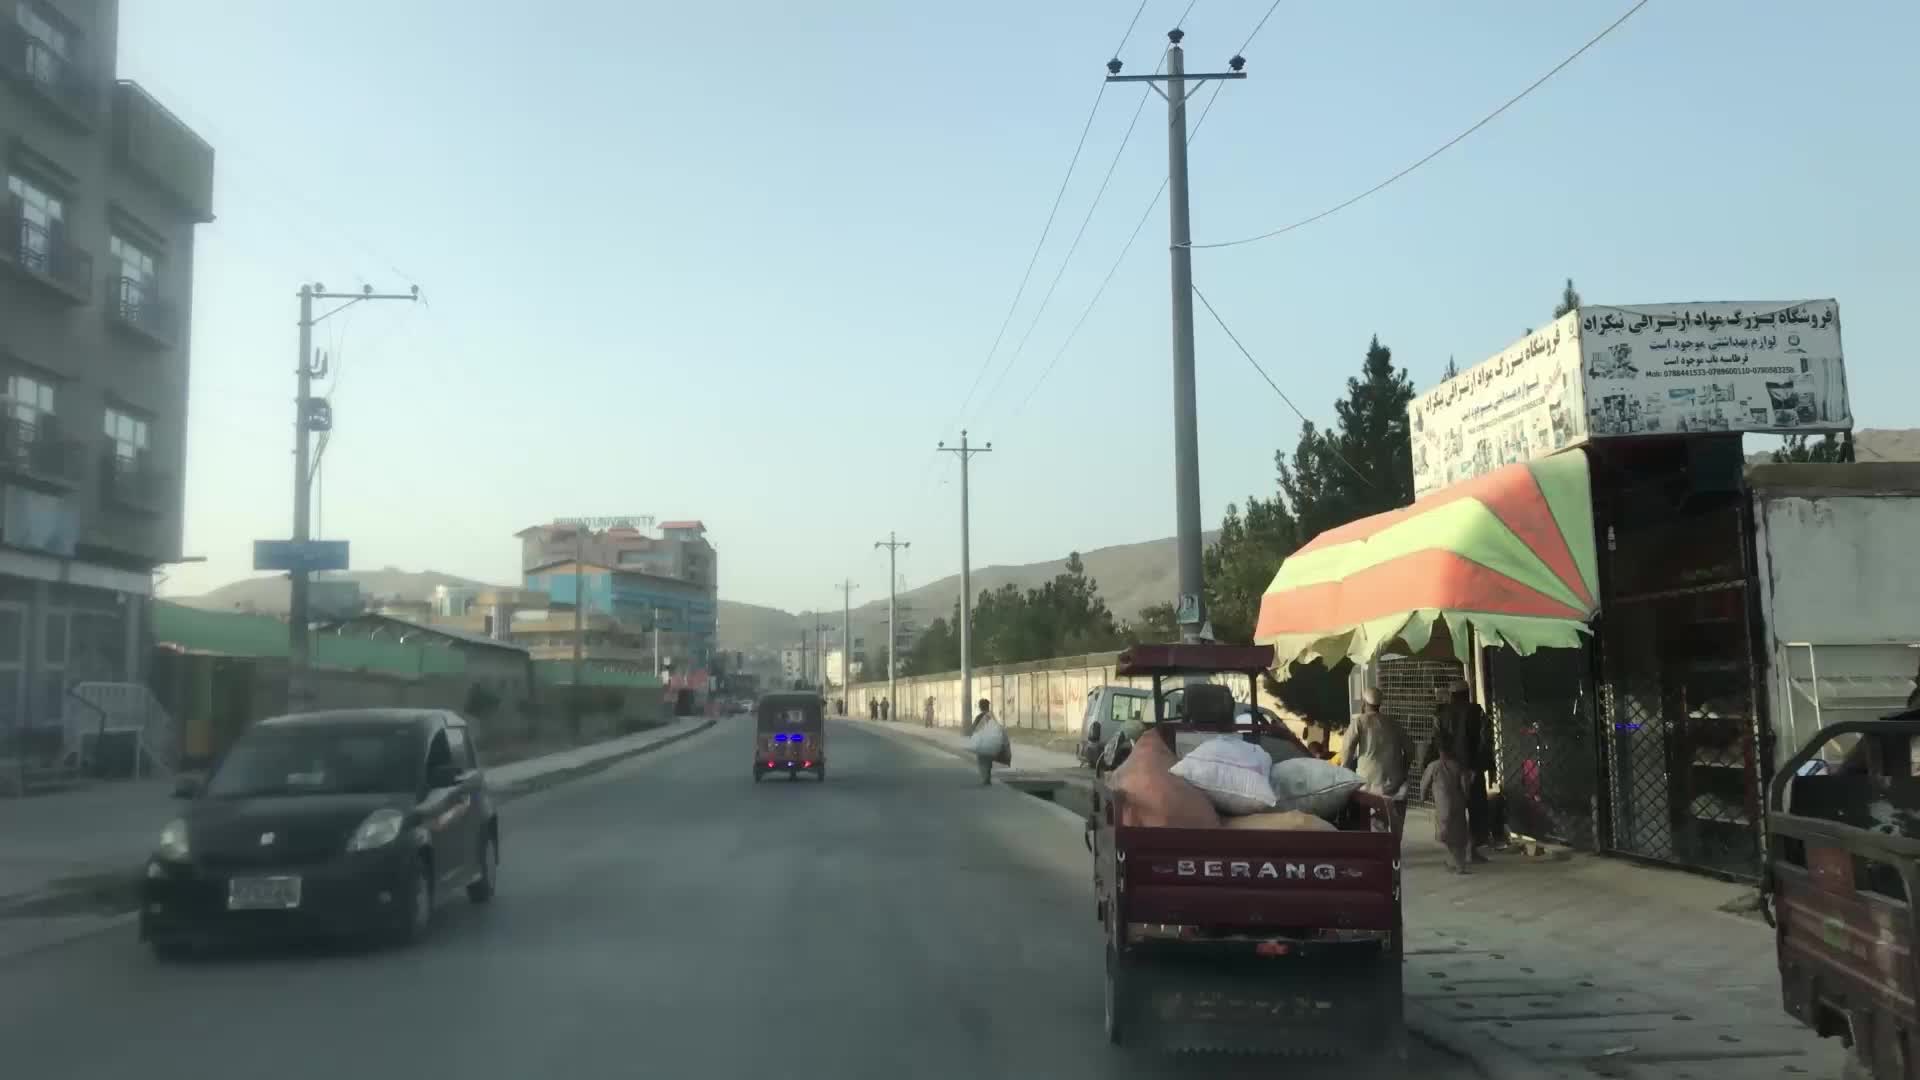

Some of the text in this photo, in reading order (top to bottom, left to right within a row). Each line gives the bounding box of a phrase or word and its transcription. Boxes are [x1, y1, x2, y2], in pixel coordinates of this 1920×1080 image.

[1695, 310, 1722, 331] مواد
[1727, 309, 1775, 329] بزرگ
[1779, 306, 1832, 328] فروشگاه
[1525, 323, 1561, 360] فروشگاه
[1649, 338, 1671, 349] است
[1674, 340, 1705, 352] موجود
[1751, 335, 1776, 349] لوازم
[1177, 859, 1337, 880] BERANG
